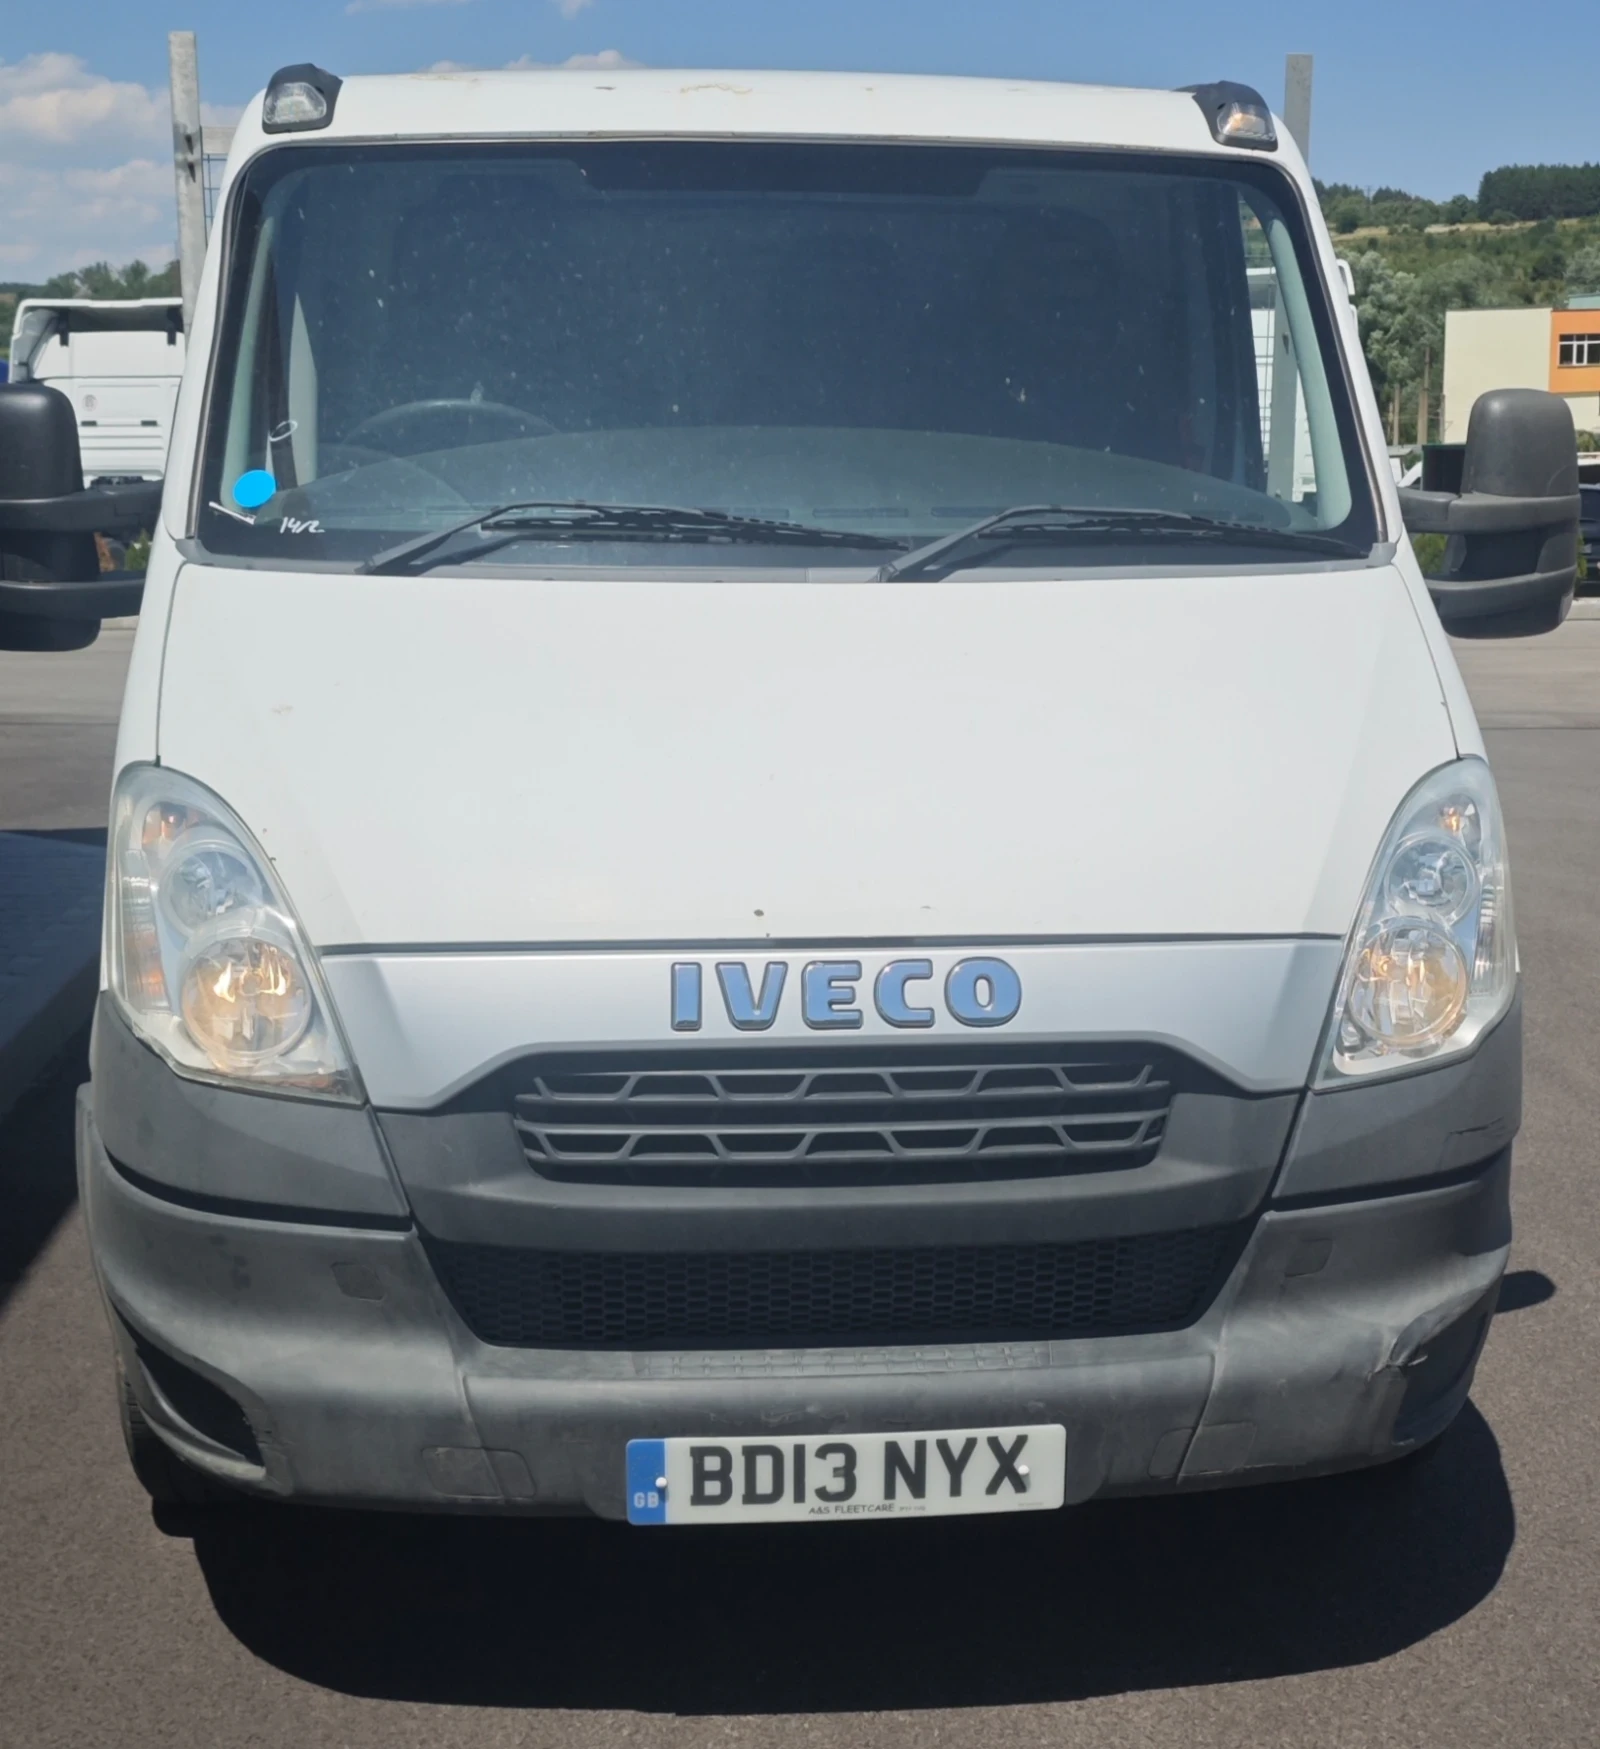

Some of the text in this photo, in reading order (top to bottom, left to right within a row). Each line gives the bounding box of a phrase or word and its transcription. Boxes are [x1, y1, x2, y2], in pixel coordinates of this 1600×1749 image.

[670, 956, 1022, 1031] IVECO
[689, 1434, 1029, 1507] BD13 NYX
[633, 1491, 660, 1509] GB
[808, 1505, 830, 1515] A&S
[834, 1502, 895, 1514] FLEETCARE
